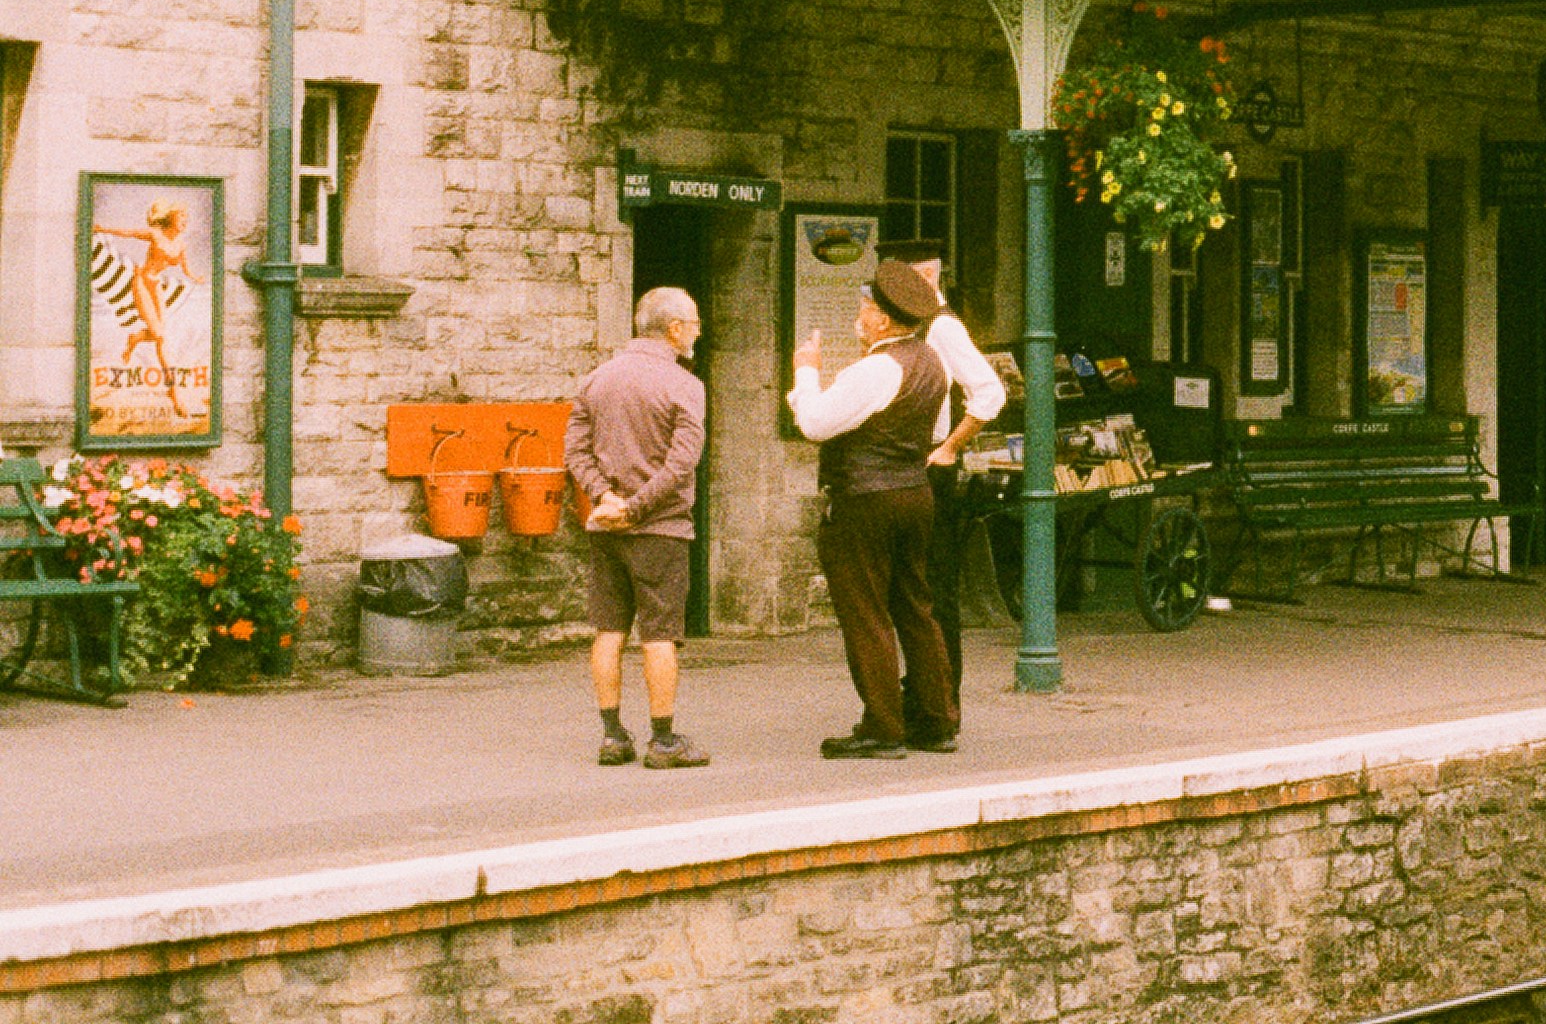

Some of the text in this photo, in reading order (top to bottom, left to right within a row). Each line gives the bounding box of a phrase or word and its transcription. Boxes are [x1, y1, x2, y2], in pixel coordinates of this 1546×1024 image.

[1500, 149, 1538, 168] WAY
[625, 174, 649, 185] NEXT
[669, 180, 765, 202] NORDEN ONLY
[94, 365, 209, 388] EXMOUTH
